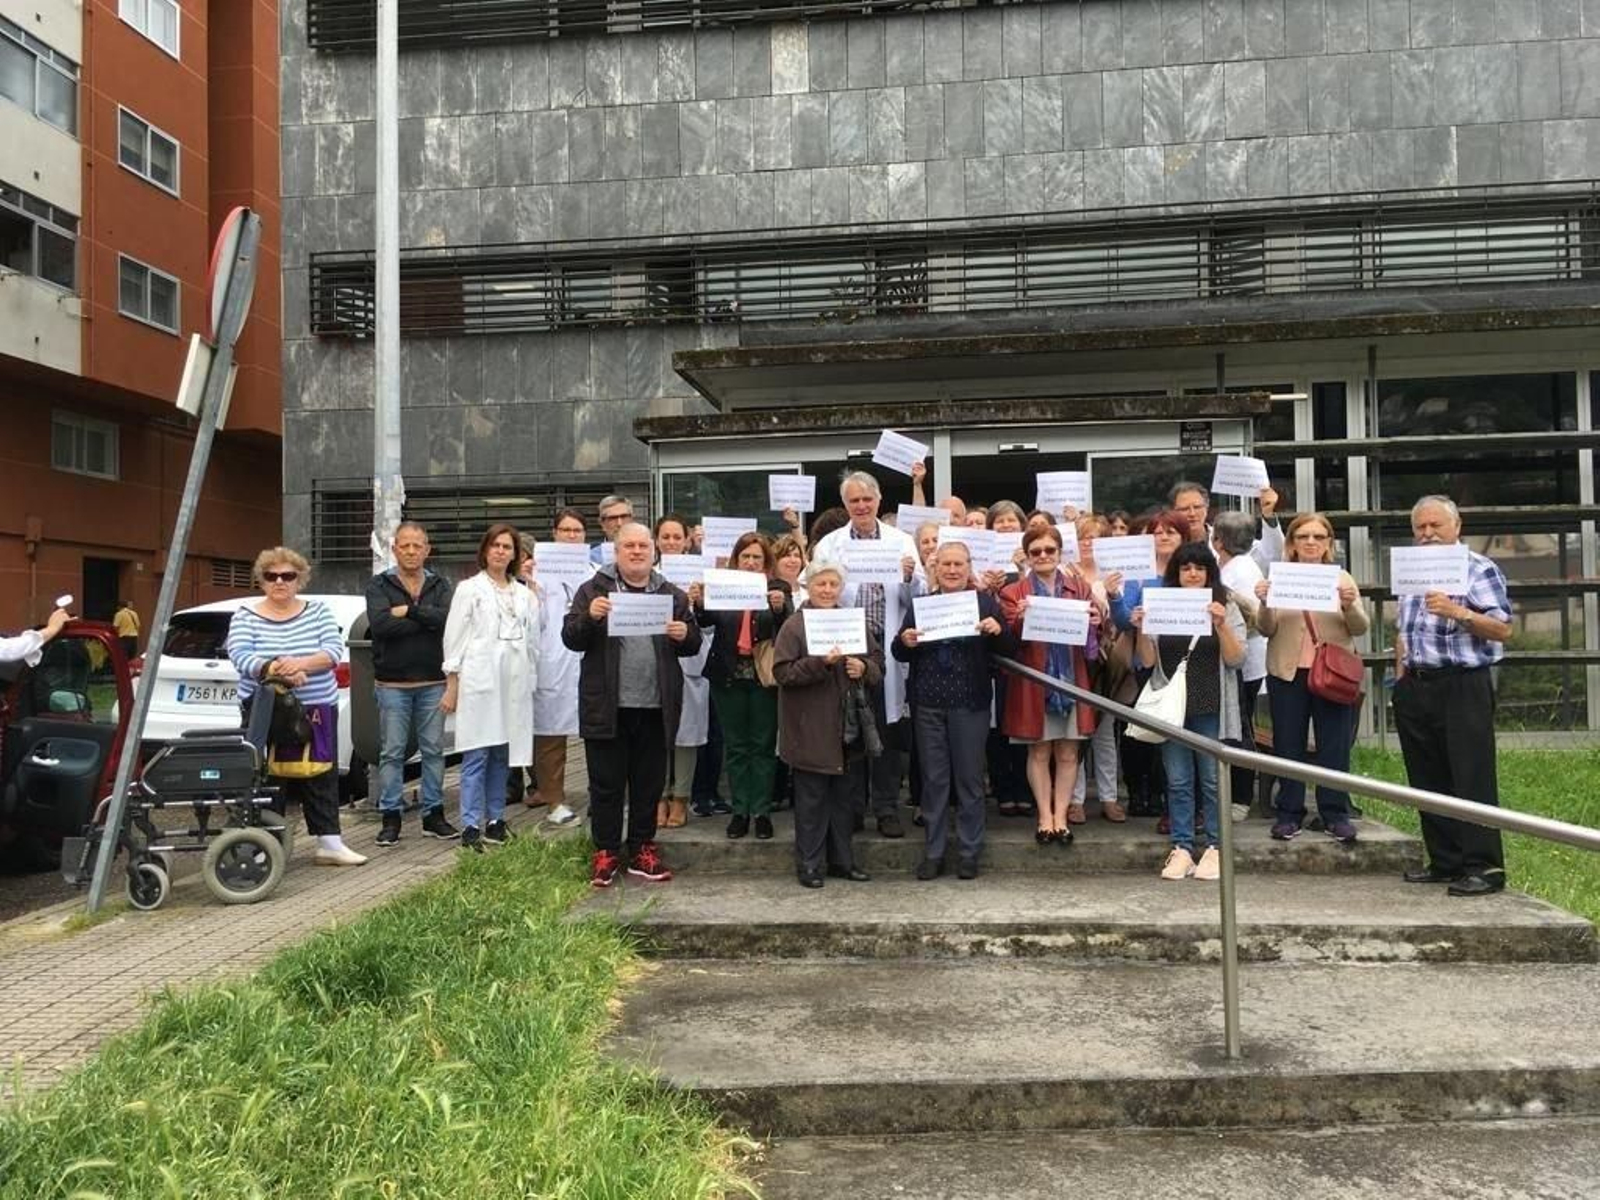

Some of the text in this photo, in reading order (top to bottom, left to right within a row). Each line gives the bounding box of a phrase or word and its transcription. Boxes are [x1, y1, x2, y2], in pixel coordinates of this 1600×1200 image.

[1273, 591, 1332, 601] GRACIAS GALICIA
[1148, 617, 1178, 625] GRACIAS
[187, 686, 238, 701] 7561 KP
